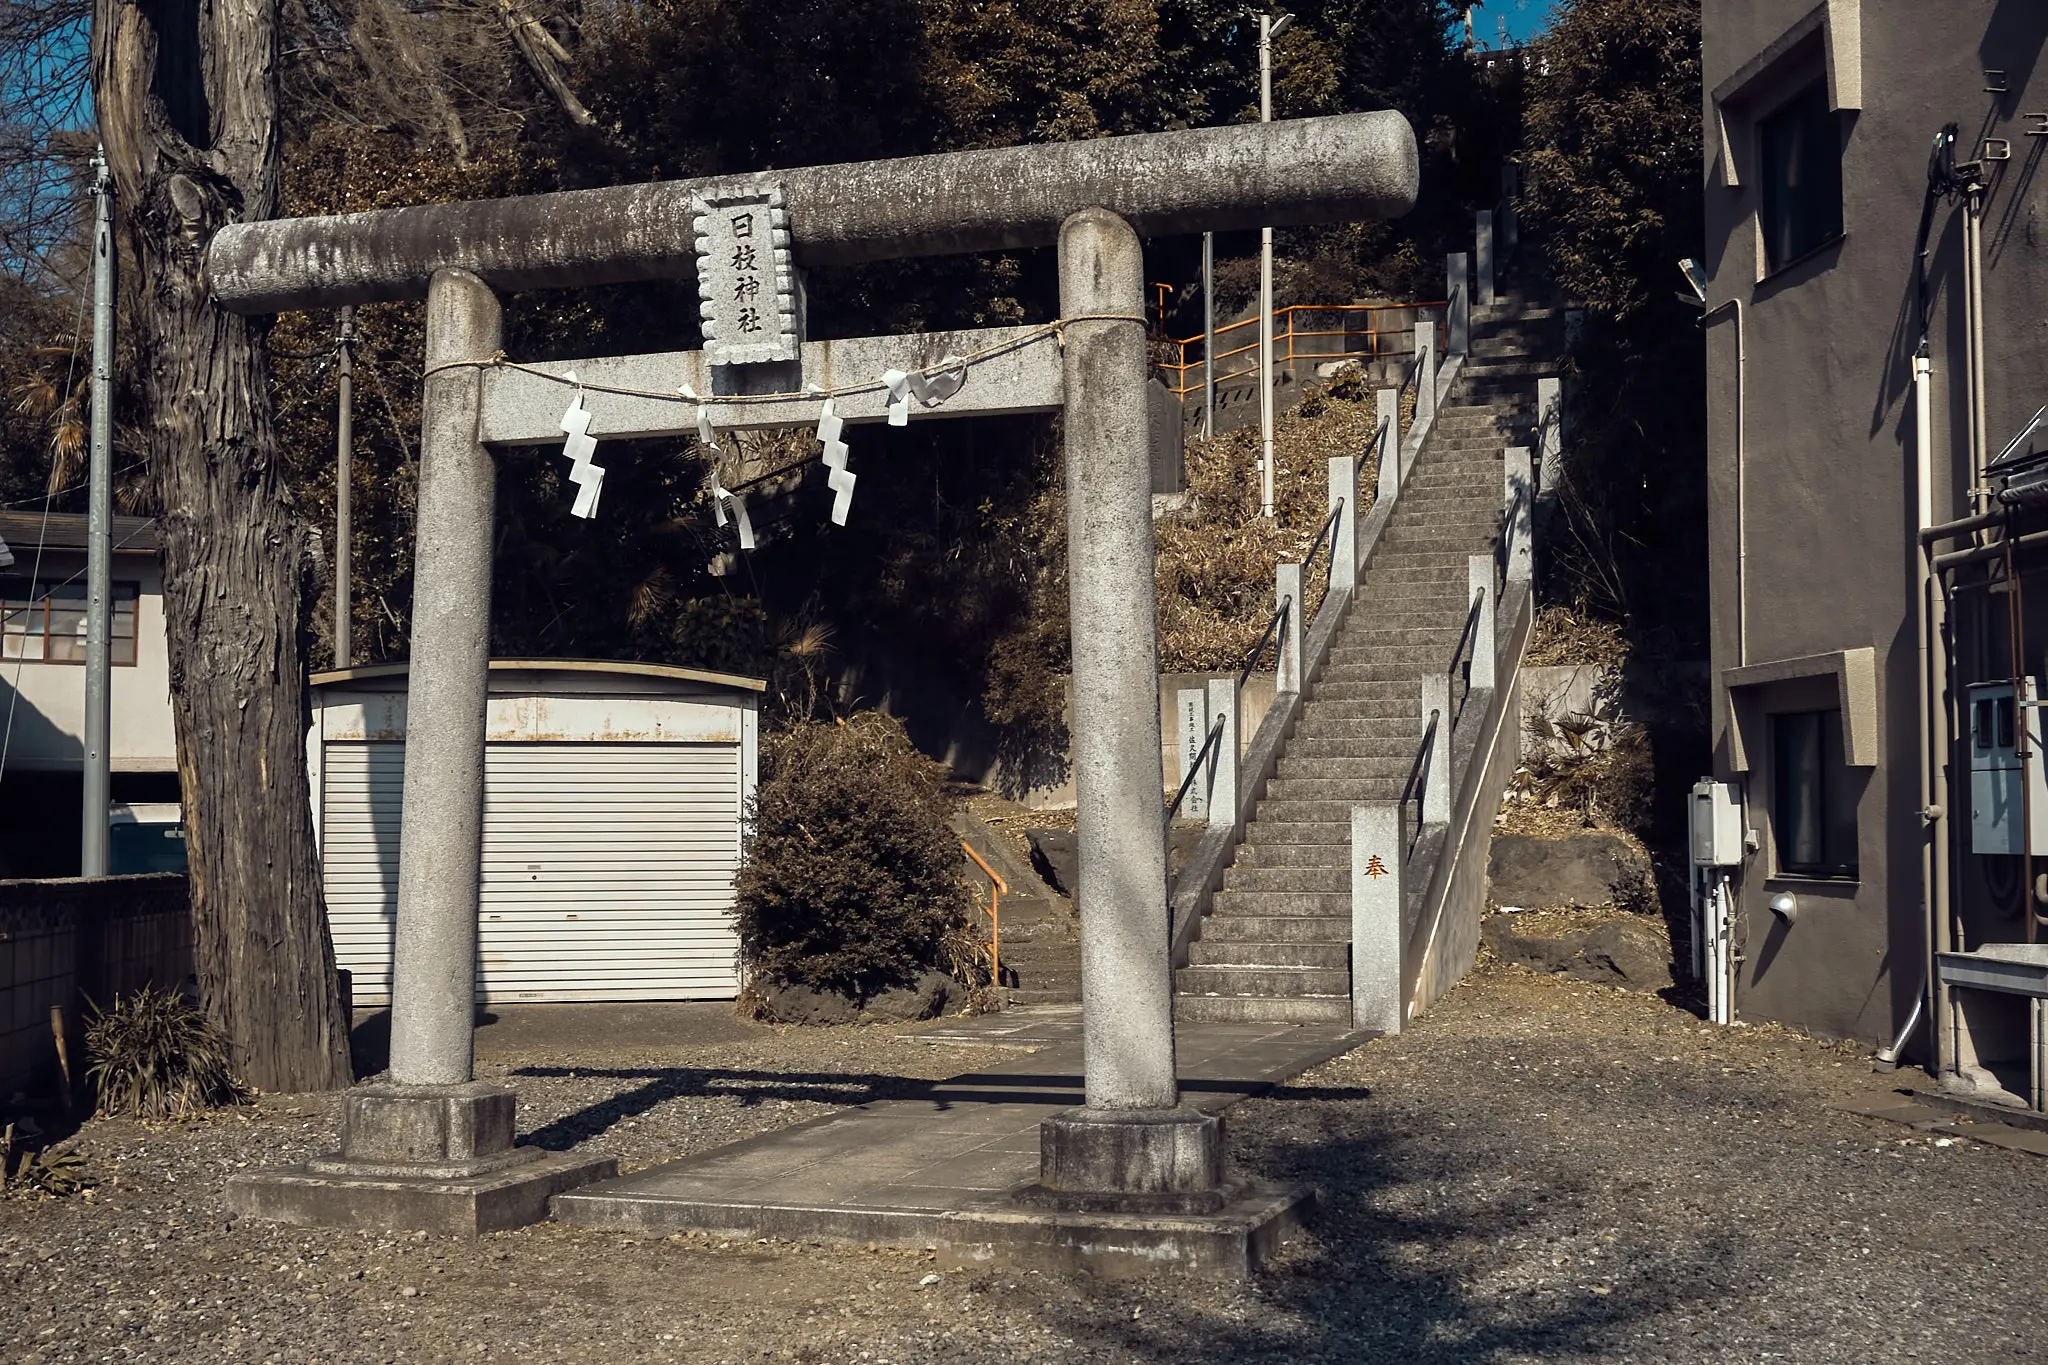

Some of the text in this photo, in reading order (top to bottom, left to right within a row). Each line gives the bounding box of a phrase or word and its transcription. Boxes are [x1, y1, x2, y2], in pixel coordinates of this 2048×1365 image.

[731, 213, 762, 333] 日枝神社
[1364, 854, 1389, 880] 奉
